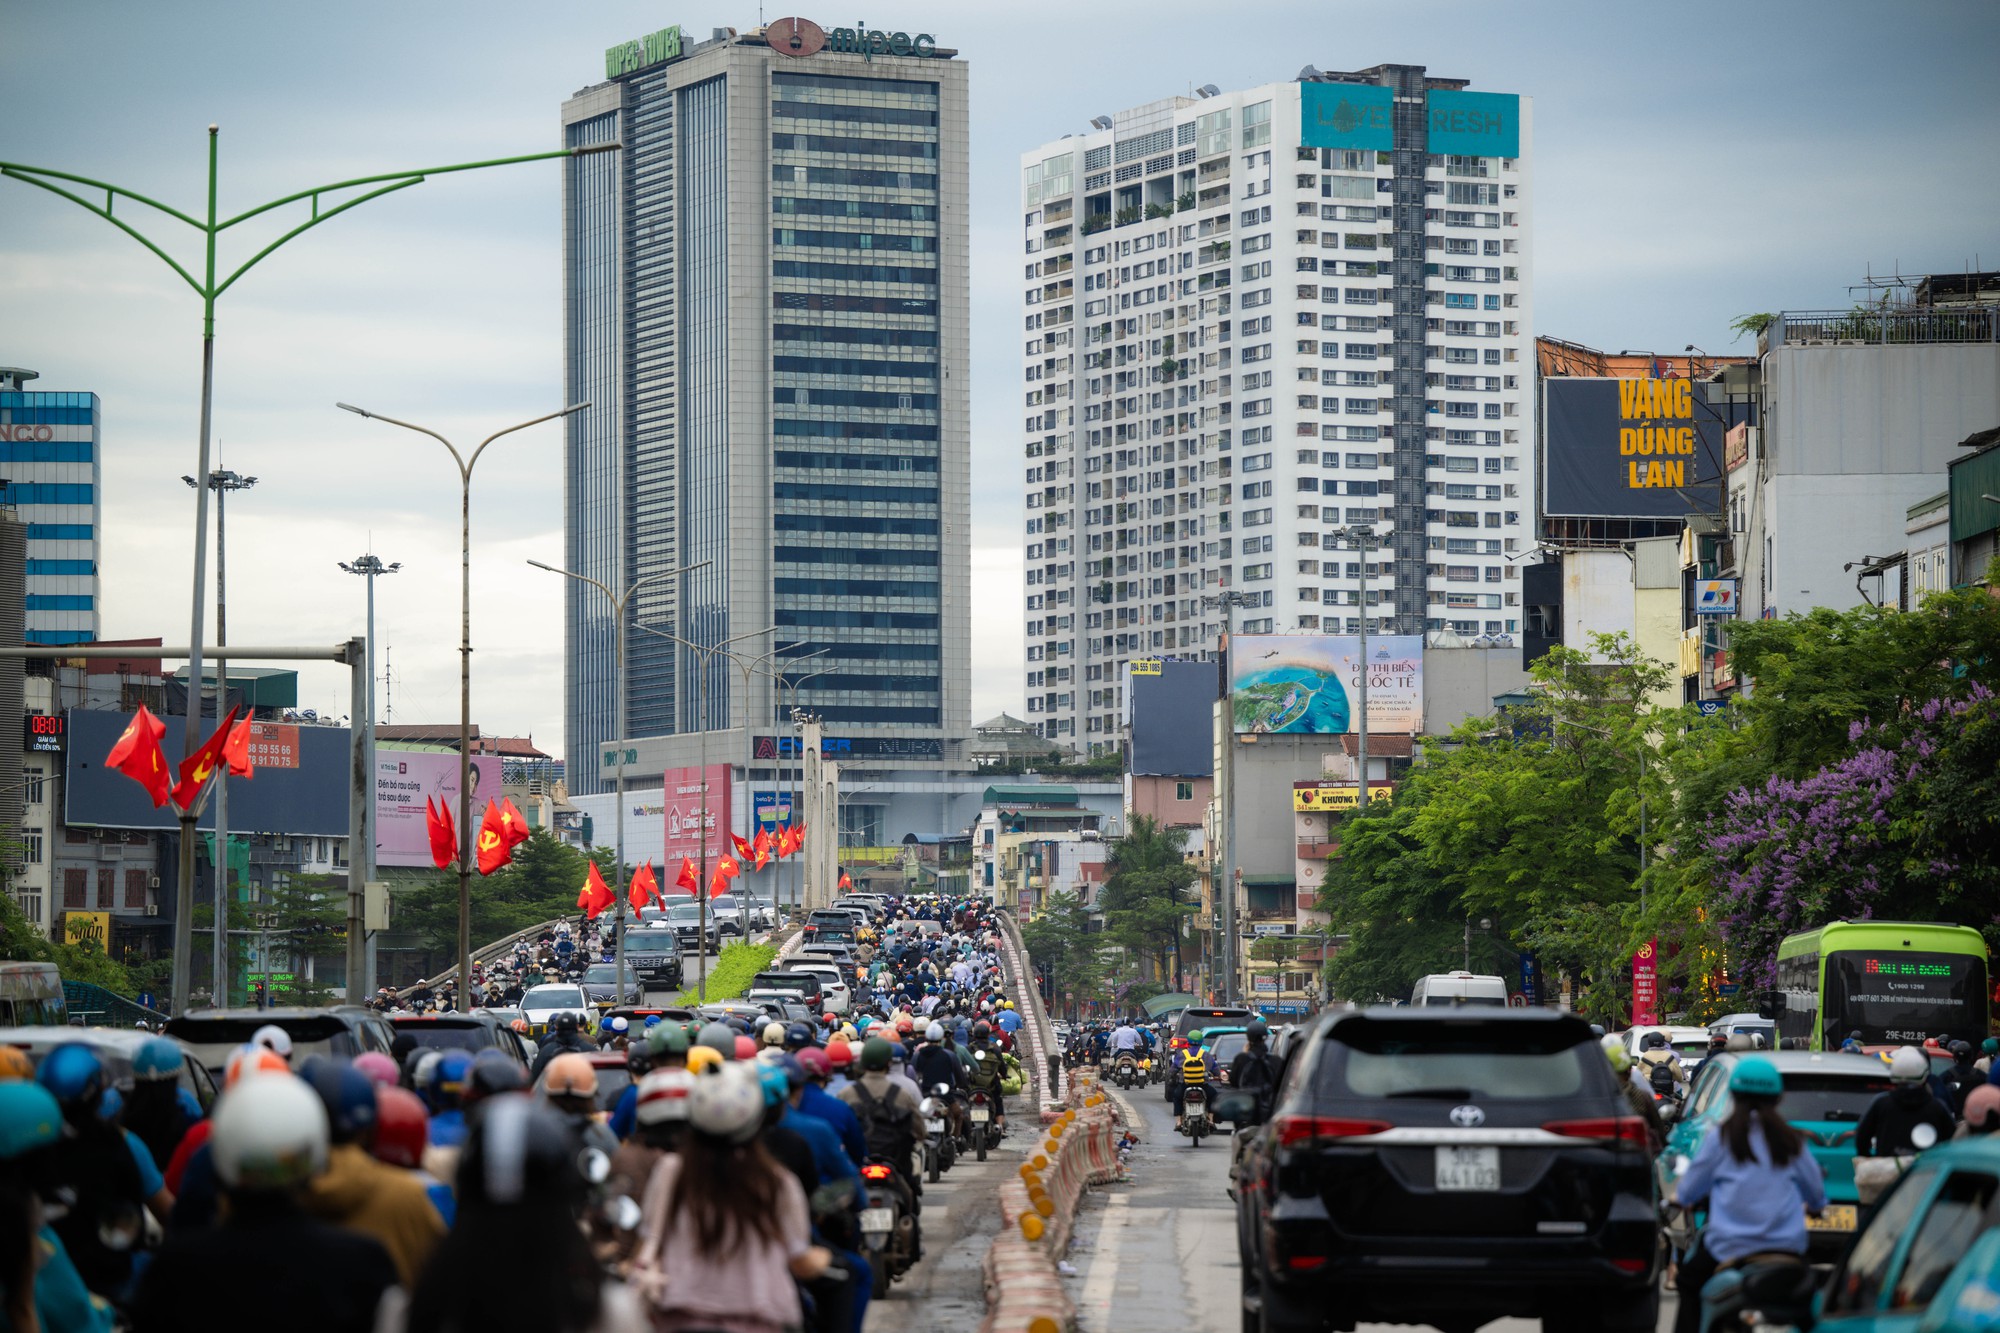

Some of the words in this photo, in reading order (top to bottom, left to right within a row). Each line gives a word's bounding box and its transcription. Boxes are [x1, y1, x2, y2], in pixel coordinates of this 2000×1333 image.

[831, 21, 935, 62] mipec
[605, 40, 640, 80] MIPEC
[642, 25, 681, 66] TOWER
[1619, 371, 1693, 419] VÀNG
[1620, 421, 1693, 455] DŨNG
[1629, 460, 1684, 488] LAN
[1140, 663, 1148, 671] 555
[1371, 664, 1389, 675] THỊ
[1392, 660, 1416, 672] BIỂN
[1396, 673, 1415, 688] TẾ
[32, 716, 62, 734] 08:01
[259, 744, 268, 754] 59
[270, 745, 279, 754] 55
[282, 746, 290, 754] 66
[779, 738, 850, 752] CYER
[258, 756, 267, 764] 91
[270, 756, 279, 765] 70
[282, 757, 290, 766] 75
[1322, 796, 1353, 804] KHƯƠNG
[1886, 1030, 1926, 1040] 29E-422.85
